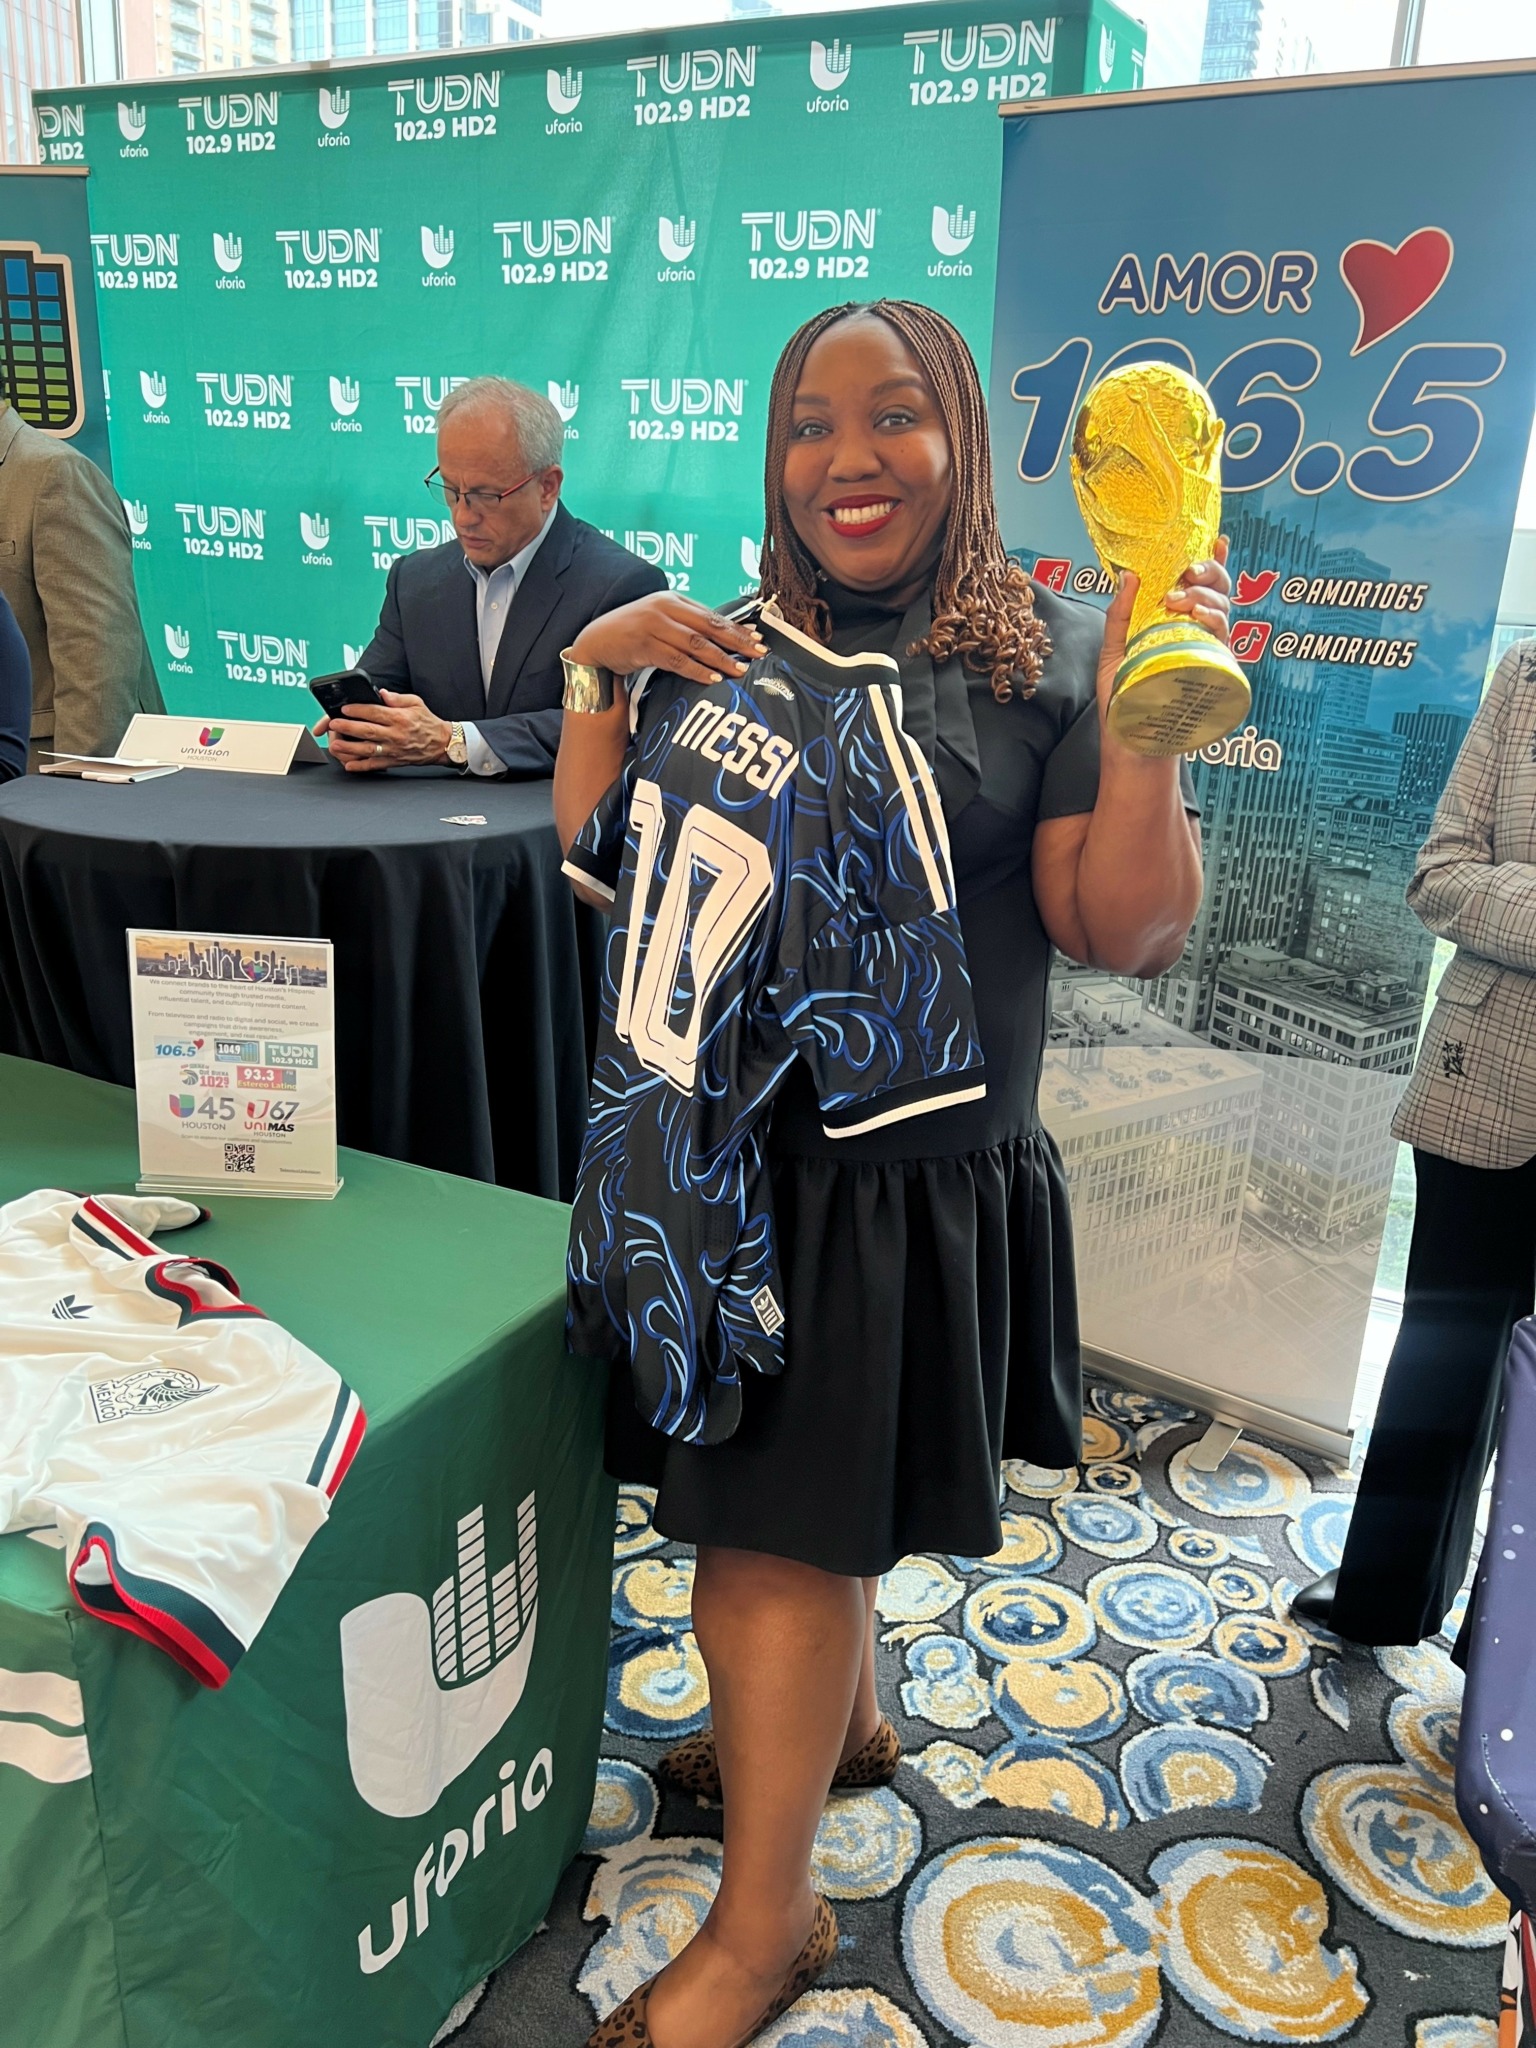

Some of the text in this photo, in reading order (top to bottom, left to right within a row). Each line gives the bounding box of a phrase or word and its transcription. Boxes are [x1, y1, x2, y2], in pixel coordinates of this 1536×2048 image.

[904, 18, 1055, 75] TUDN
[627, 46, 755, 98] TUDN
[388, 71, 500, 116] TUDN
[910, 72, 1047, 105] 102.9 HD2
[179, 92, 277, 130] TUDN
[635, 95, 750, 125] 102.9 HD2
[807, 95, 848, 112] uforia
[33, 105, 84, 138] DN
[395, 115, 496, 141] 102.9 HD2
[546, 118, 582, 134] uforia
[120, 144, 148, 157] uforia
[187, 132, 275, 154] 102.9 HD2
[318, 132, 350, 147] uforia
[50, 141, 84, 161] HD2
[494, 216, 611, 258] TUDN
[742, 209, 875, 251] TUDN
[90, 234, 179, 266] TUDN
[276, 228, 379, 264] TUDN
[285, 269, 377, 288] 102.9 HD2
[502, 261, 607, 284] 102.9 HD2
[658, 266, 695, 282] uforia
[749, 256, 868, 279] 102.9 HD2
[928, 260, 972, 276] uforia
[98, 271, 177, 288] 102.9 HD2
[216, 276, 245, 289] uforia
[422, 272, 455, 286] uforia
[1098, 250, 1318, 314] AMOR
[196, 373, 291, 406] TUDN
[395, 376, 469, 410] TU
[622, 379, 743, 415] TUDN
[144, 412, 170, 423] uforia
[205, 409, 290, 429] 102.9 HD2
[331, 419, 362, 432] uforia
[564, 425, 579, 439] ria
[629, 421, 738, 441] 102.9 HD2
[175, 504, 265, 540] TUDN
[131, 536, 152, 550] foria
[184, 538, 263, 560] 102.9 HD2
[302, 553, 332, 565] uforia
[664, 571, 690, 591] D2
[1281, 577, 1429, 612] @AMOR1065
[217, 631, 308, 669] TUDN
[1273, 633, 1418, 668] @AMOR1065
[168, 661, 193, 673] uforia
[226, 664, 307, 688] 102.9 HD2
[671, 699, 799, 800] MESSI
[1186, 726, 1282, 771] oria
[615, 778, 774, 1097] 10
[155, 1044, 196, 1058] 106.5
[268, 1045, 315, 1059] TUDN
[272, 1057, 314, 1066] 102.9 HD2
[238, 1080, 269, 1089] Estereo
[244, 1068, 275, 1081] 93.3
[197, 1096, 236, 1121] 45
[270, 1101, 300, 1121] 67
[181, 1121, 226, 1131] HOUSTON
[358, 1747, 553, 1974] uforia
